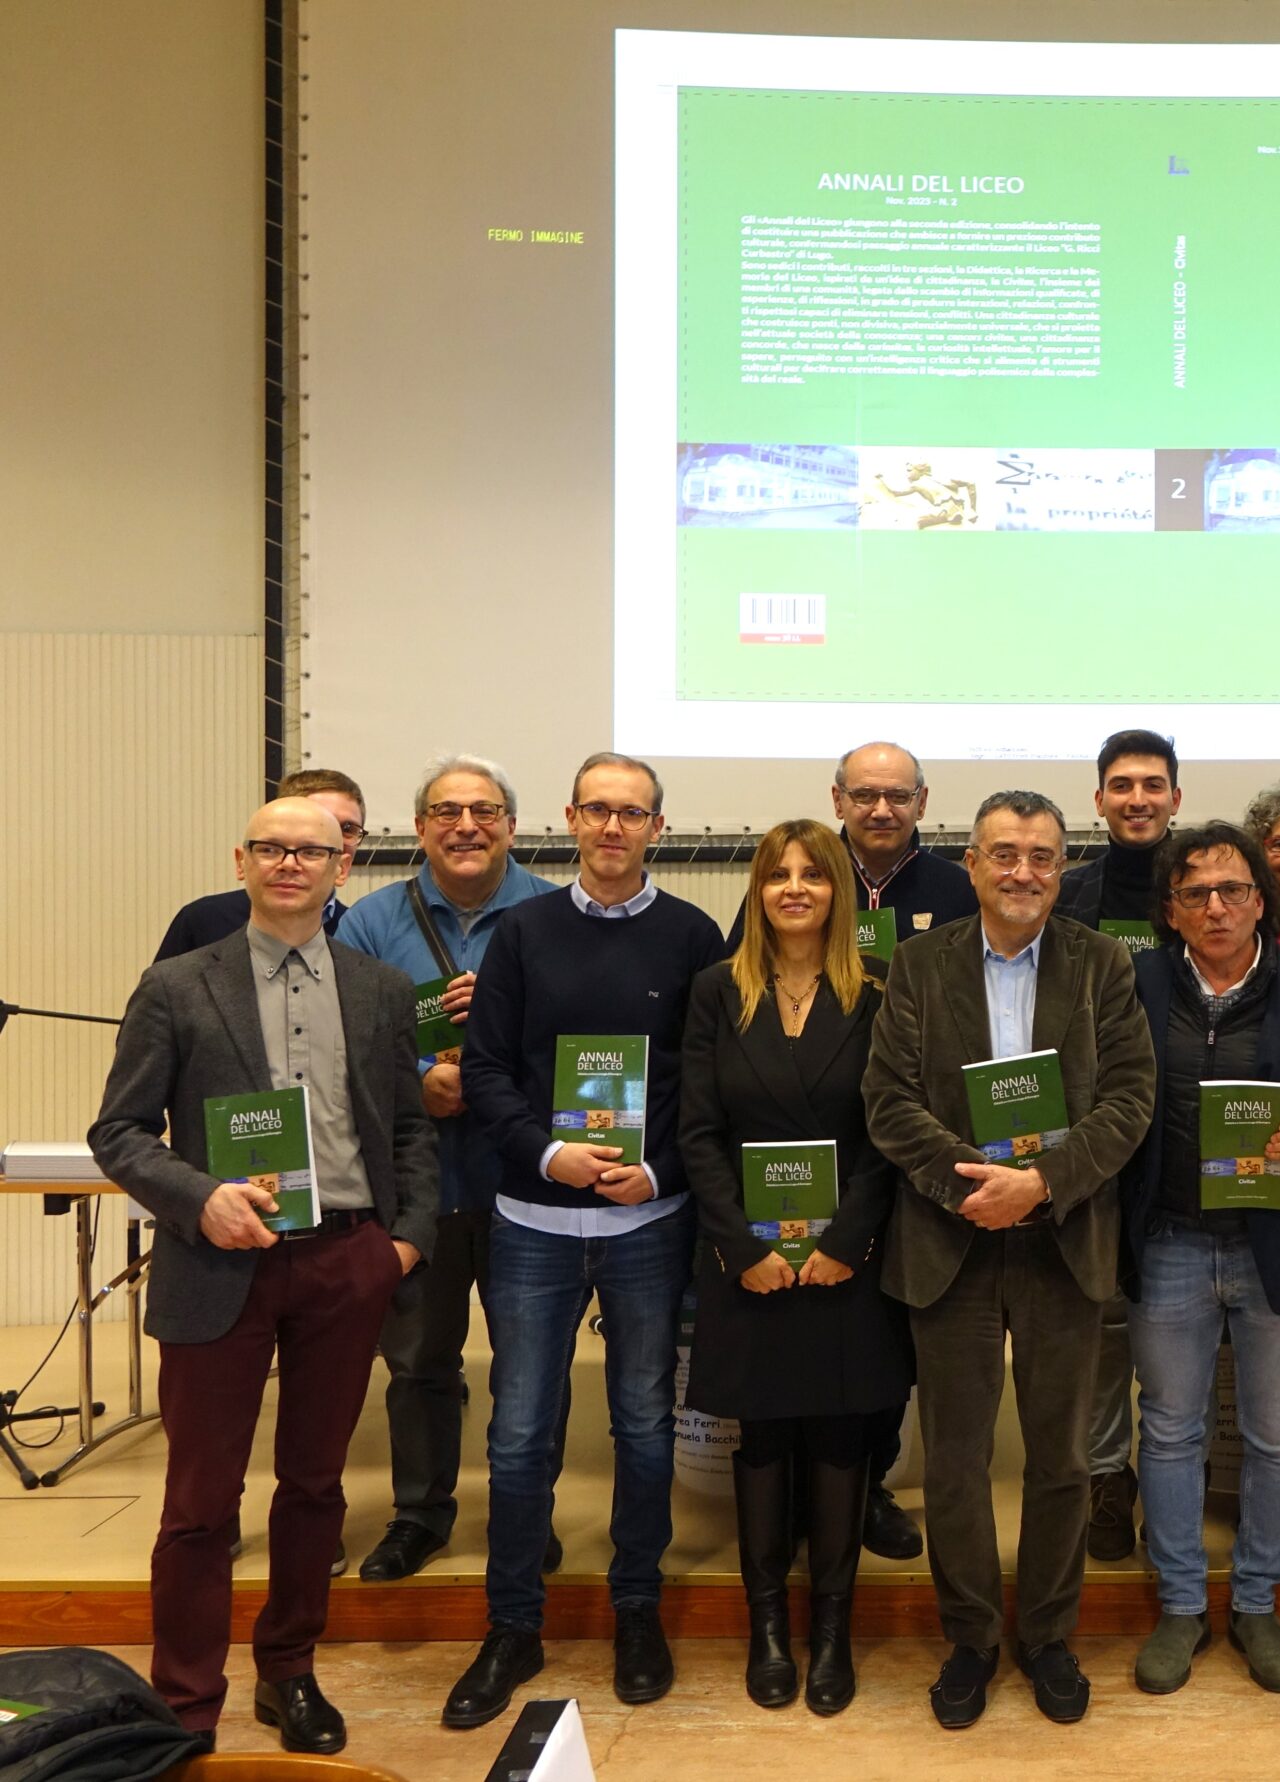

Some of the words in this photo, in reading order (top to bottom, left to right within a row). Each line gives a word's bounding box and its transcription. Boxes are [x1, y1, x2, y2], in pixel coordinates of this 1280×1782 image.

[817, 172, 904, 192] ANNALI
[911, 174, 954, 193] DEL
[960, 175, 1025, 194] LICEO
[488, 229, 523, 242] FERMO
[530, 230, 584, 244] IMMAGINE
[1173, 280, 1187, 315] LICEO
[1173, 317, 1187, 340] DEL
[1173, 345, 1187, 389] ANNALI
[1170, 477, 1187, 499] 2
[578, 1051, 623, 1062] ANNALI
[577, 1062, 594, 1071] DEL
[596, 1062, 624, 1071] LICEO
[991, 1073, 1037, 1092] ANNALI
[991, 1090, 1010, 1101] DEL
[1012, 1084, 1040, 1097] LICEO
[1224, 1101, 1271, 1112] ANNALI
[230, 1108, 281, 1126] ANNALI
[1224, 1111, 1242, 1120] DEL
[1244, 1111, 1272, 1120] LICEO
[230, 1123, 251, 1135] DEL
[253, 1119, 283, 1132] LICEO
[765, 1162, 811, 1173] ANNALI
[765, 1173, 783, 1182] DEL
[785, 1172, 813, 1181] LICEO
[694, 1417, 720, 1429] Ferri
